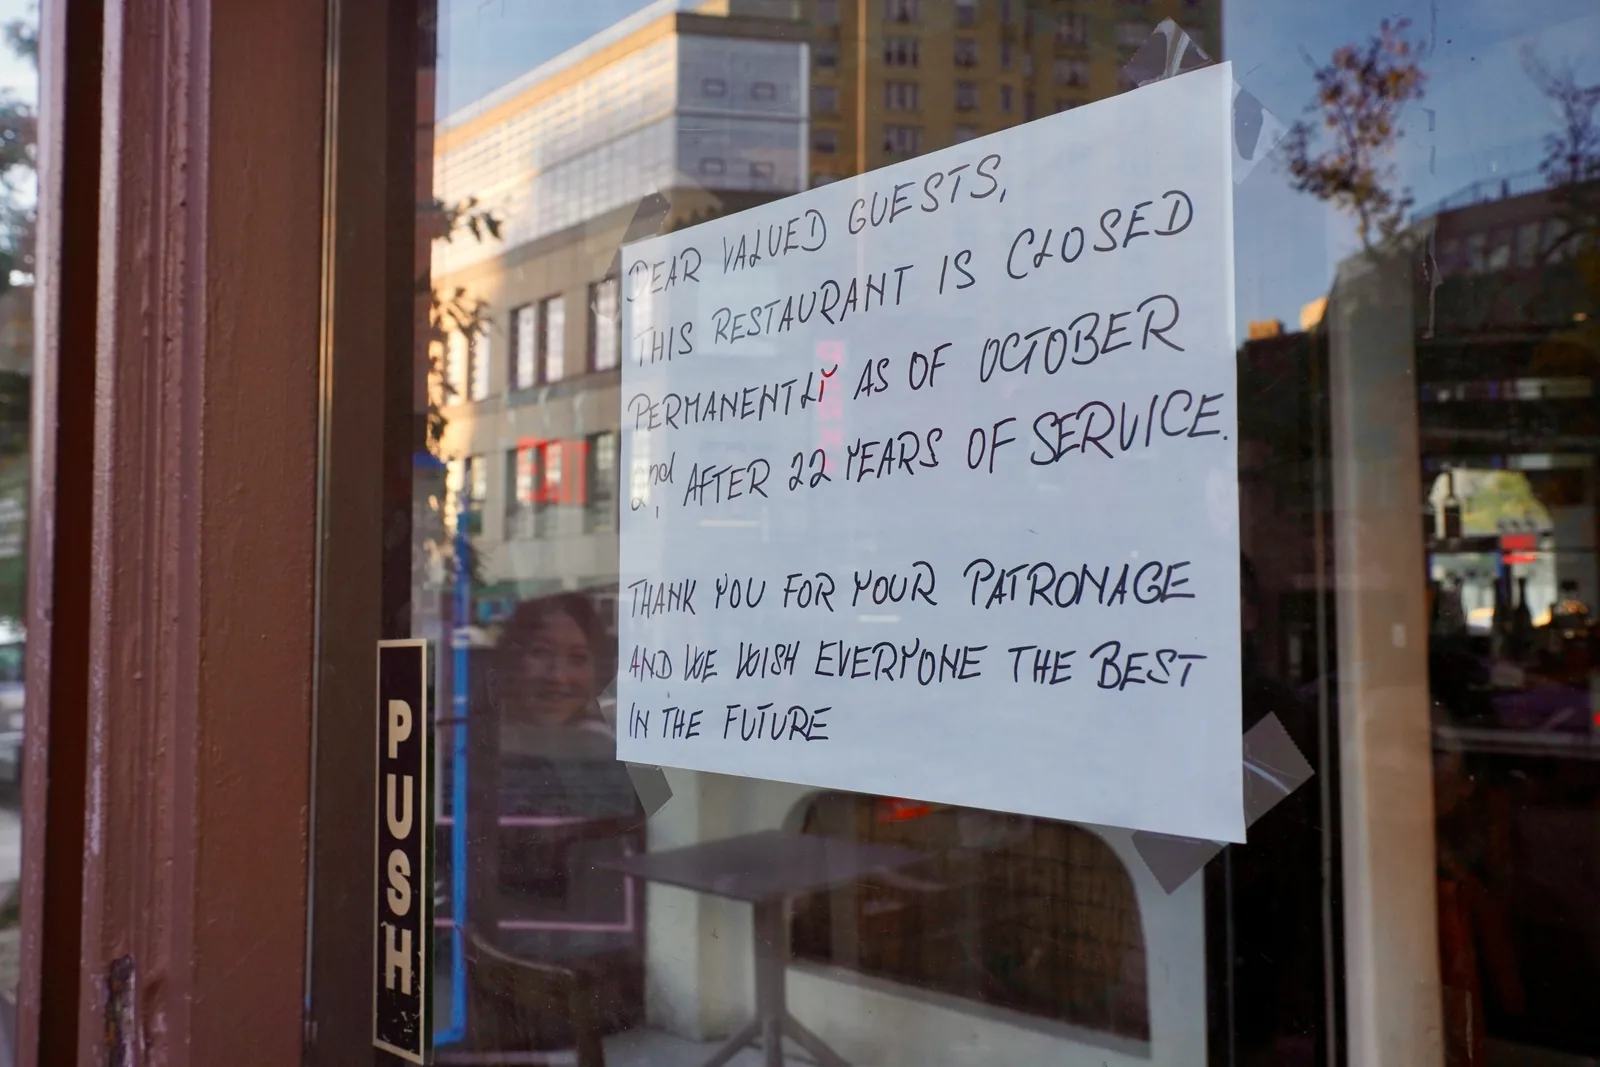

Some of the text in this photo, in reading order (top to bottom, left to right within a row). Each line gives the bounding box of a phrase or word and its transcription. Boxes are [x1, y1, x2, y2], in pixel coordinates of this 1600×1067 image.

[626, 153, 1007, 302] DEAR VALUED GUESTS,
[633, 189, 1194, 368] THIS RESTAURANT IS CLOSED
[627, 363, 838, 432] PERMANENTLY
[853, 357, 890, 401] AS
[908, 342, 953, 391] OF
[979, 294, 1186, 383] OCTOBER
[516, 434, 591, 506] EXIT
[682, 457, 771, 507] AFTER
[788, 448, 832, 491] 22
[846, 427, 943, 483] YEARS
[967, 417, 1017, 474] OF
[1030, 389, 1229, 466] SERVICE.
[627, 558, 1196, 619] THANK YOU FOR YOUR PATRONAGE
[627, 637, 1208, 692] AND WE WISH EVERYONE THE BEST
[628, 701, 832, 742] IN THE FUTURE
[384, 699, 414, 996] PUSH
